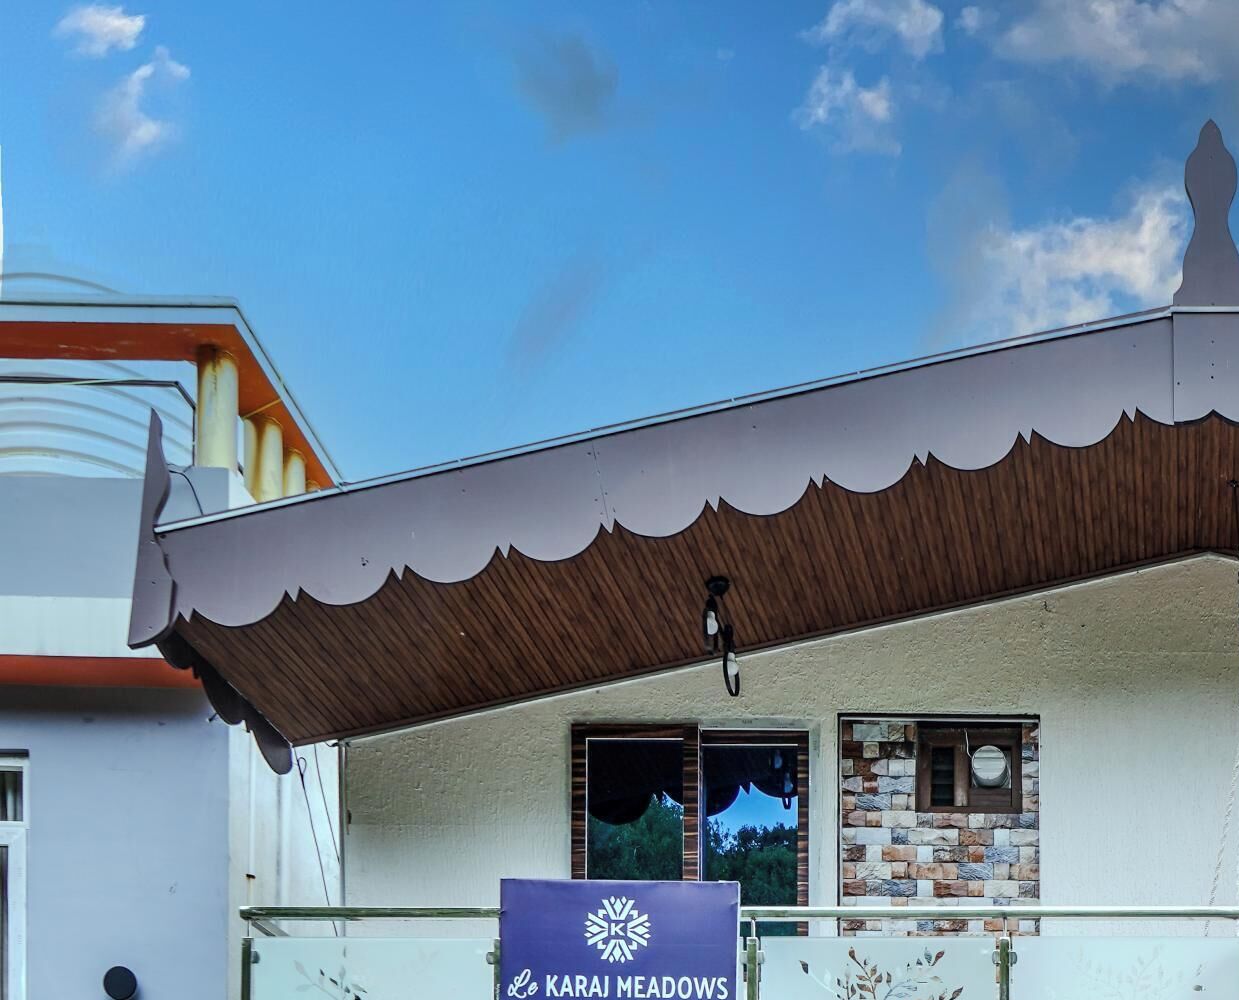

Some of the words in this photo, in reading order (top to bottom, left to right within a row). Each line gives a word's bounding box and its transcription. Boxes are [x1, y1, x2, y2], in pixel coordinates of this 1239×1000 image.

[610, 922, 625, 936] K
[507, 968, 539, 999] Le
[546, 975, 609, 998] KARAJ
[617, 976, 728, 1000] MEADOWS
